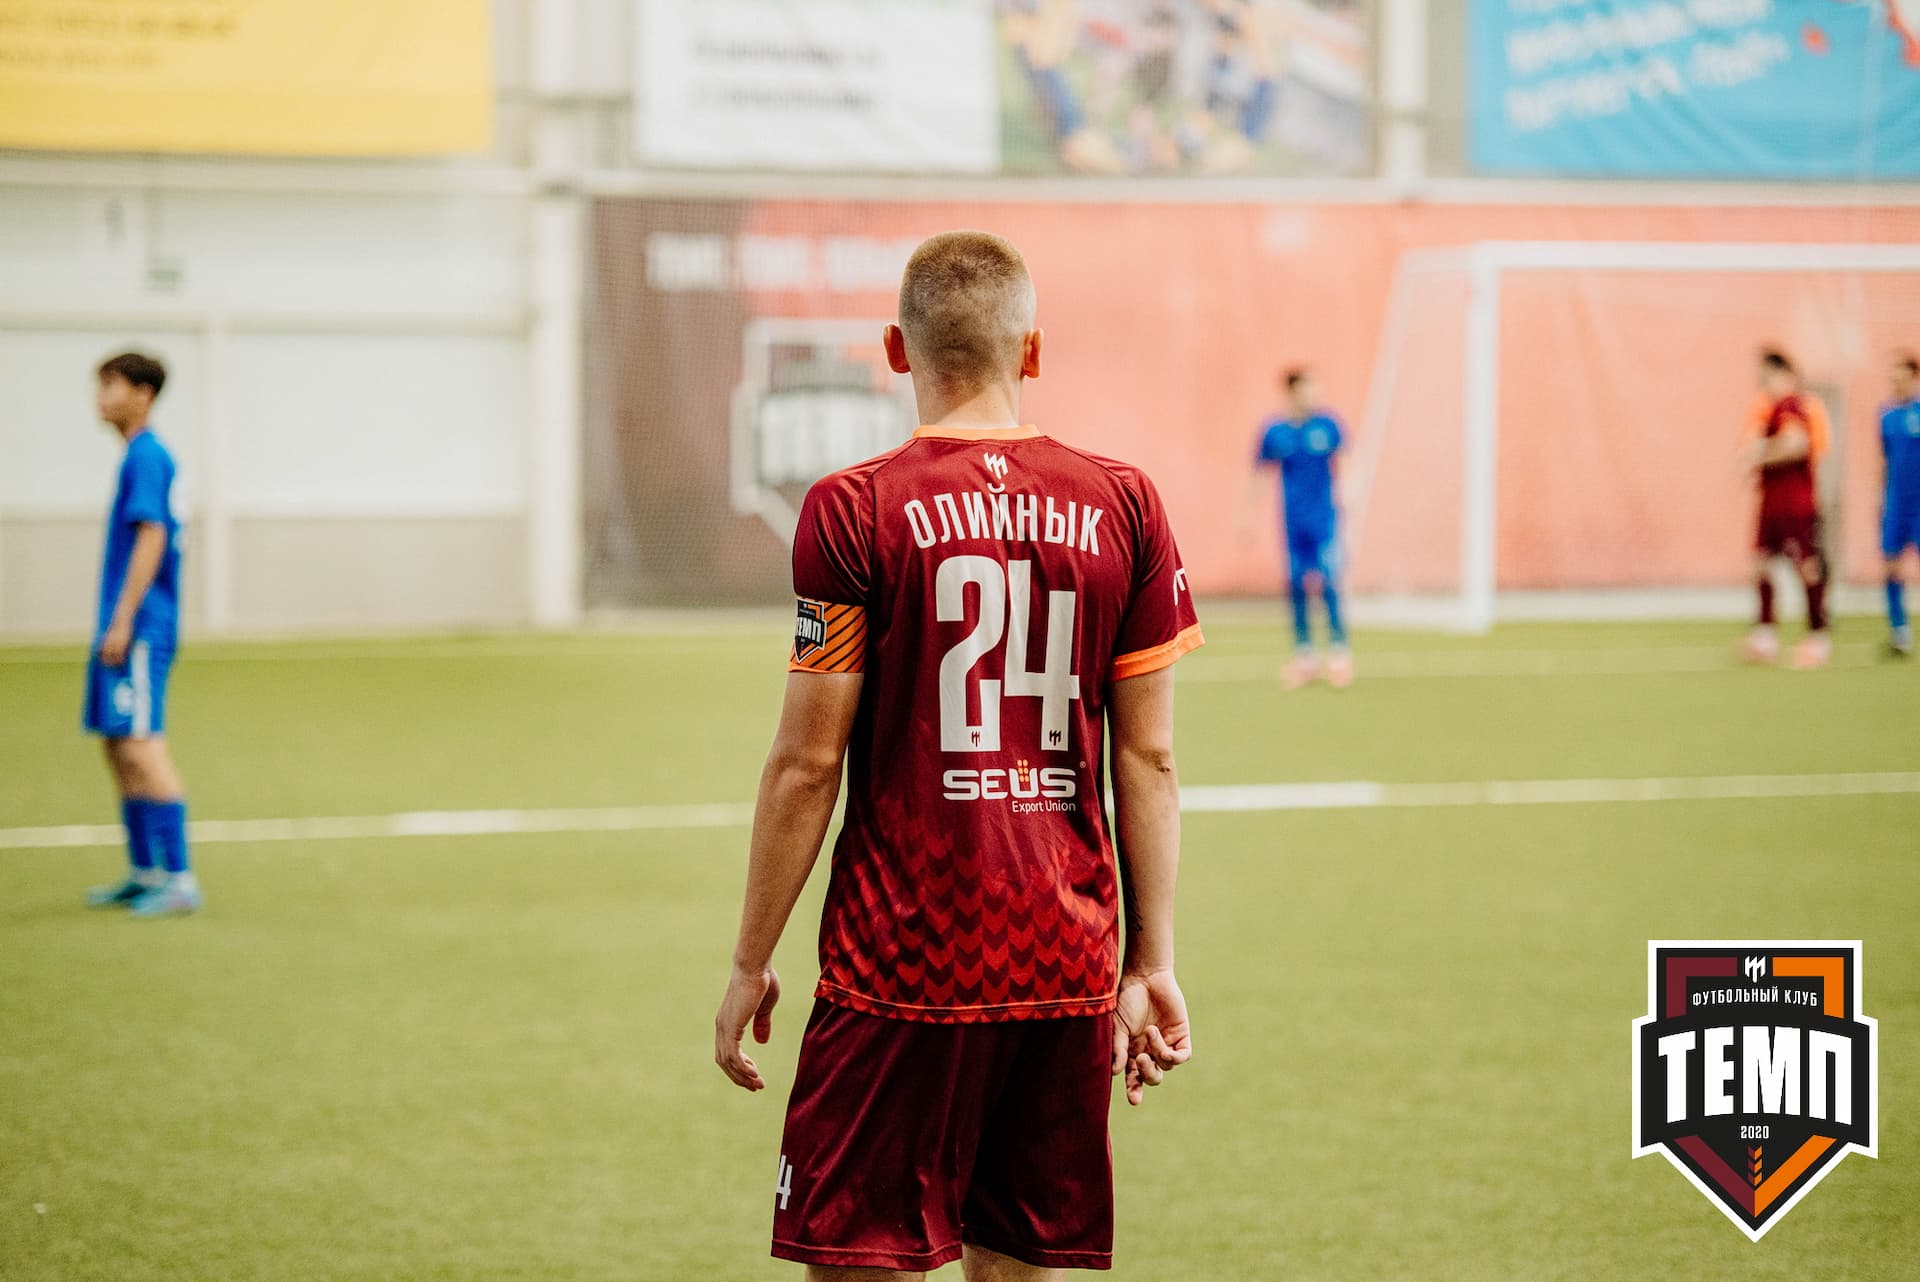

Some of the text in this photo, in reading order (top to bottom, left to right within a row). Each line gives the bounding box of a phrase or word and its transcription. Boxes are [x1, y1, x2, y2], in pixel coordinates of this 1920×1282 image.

[904, 482, 1104, 556] ОЛИЙНЫК
[797, 615, 822, 643] ЕМП
[935, 555, 1080, 752] 24
[1012, 800, 1077, 814] Export Union
